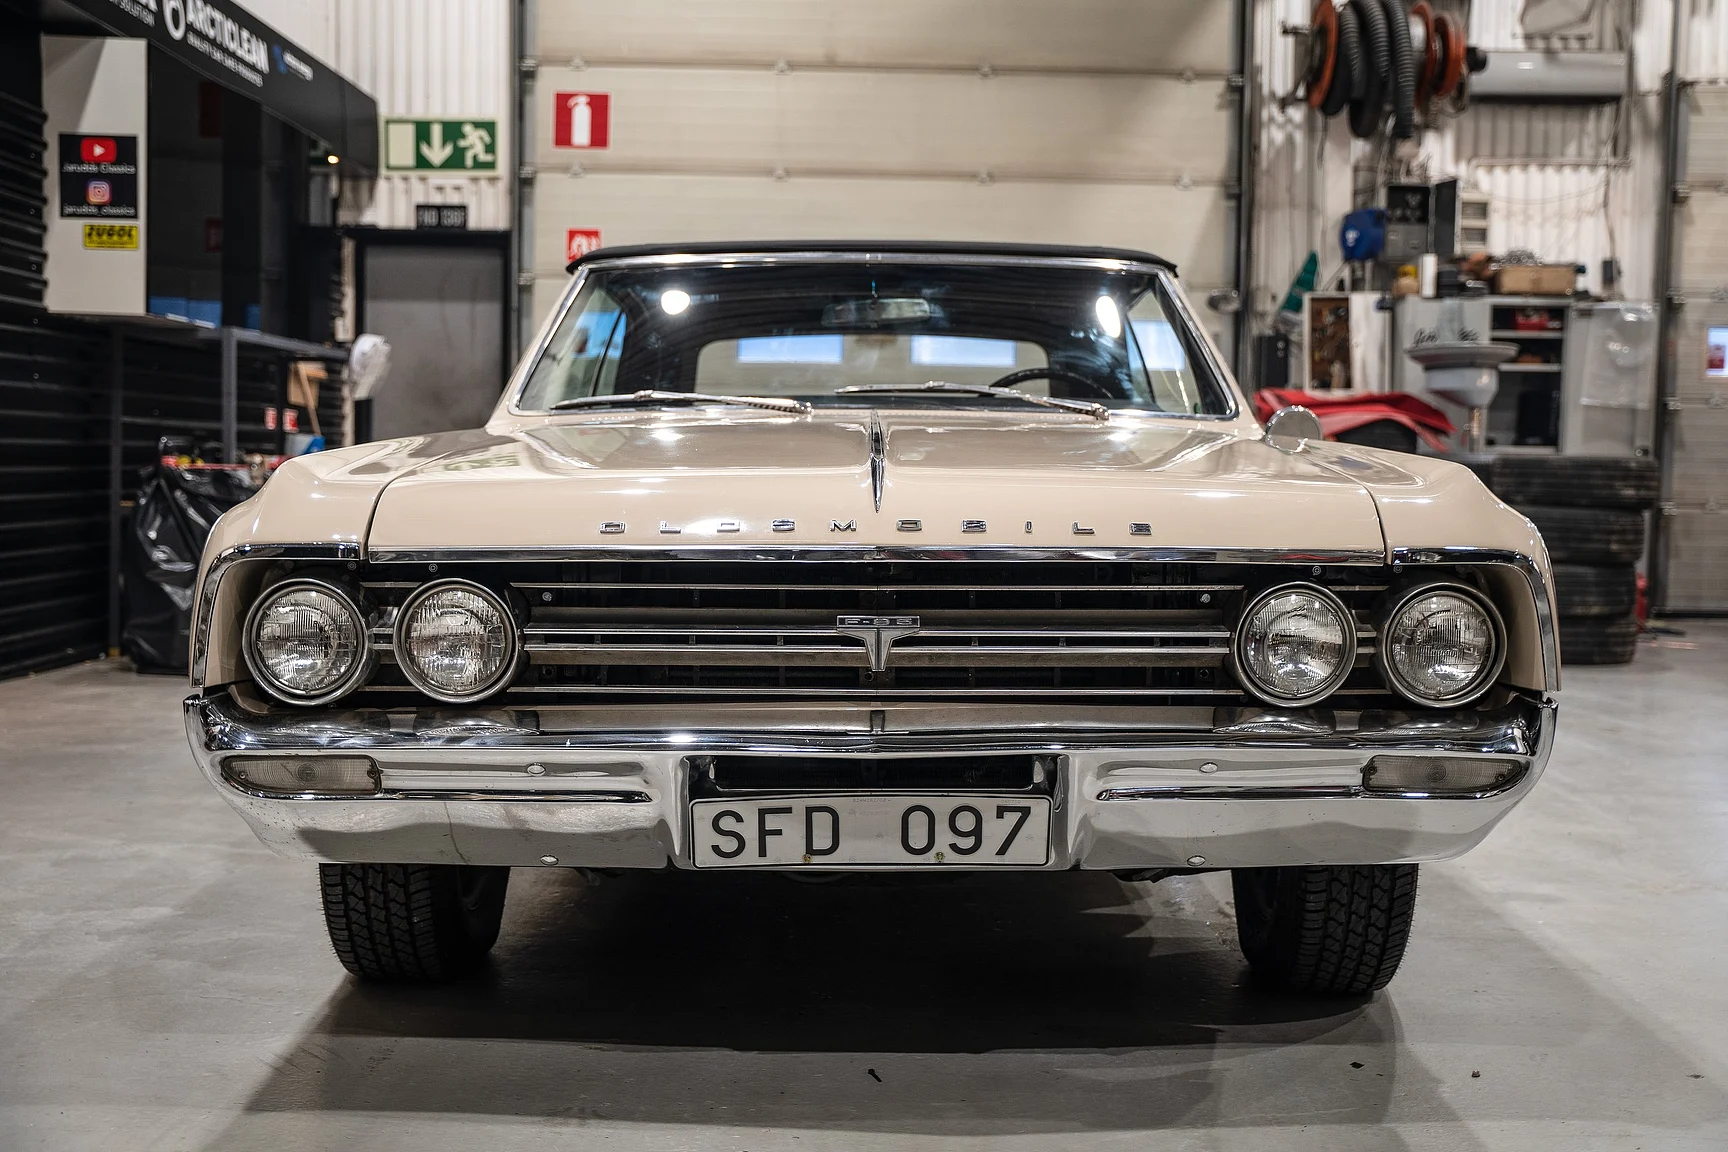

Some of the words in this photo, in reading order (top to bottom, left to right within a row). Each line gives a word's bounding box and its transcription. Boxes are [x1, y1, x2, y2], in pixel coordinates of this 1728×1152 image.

[186, 0, 269, 74] ARCTICLEAN
[600, 519, 1152, 535] OLDSMOBILE
[711, 806, 840, 859] SFD
[901, 805, 1032, 856] 097
